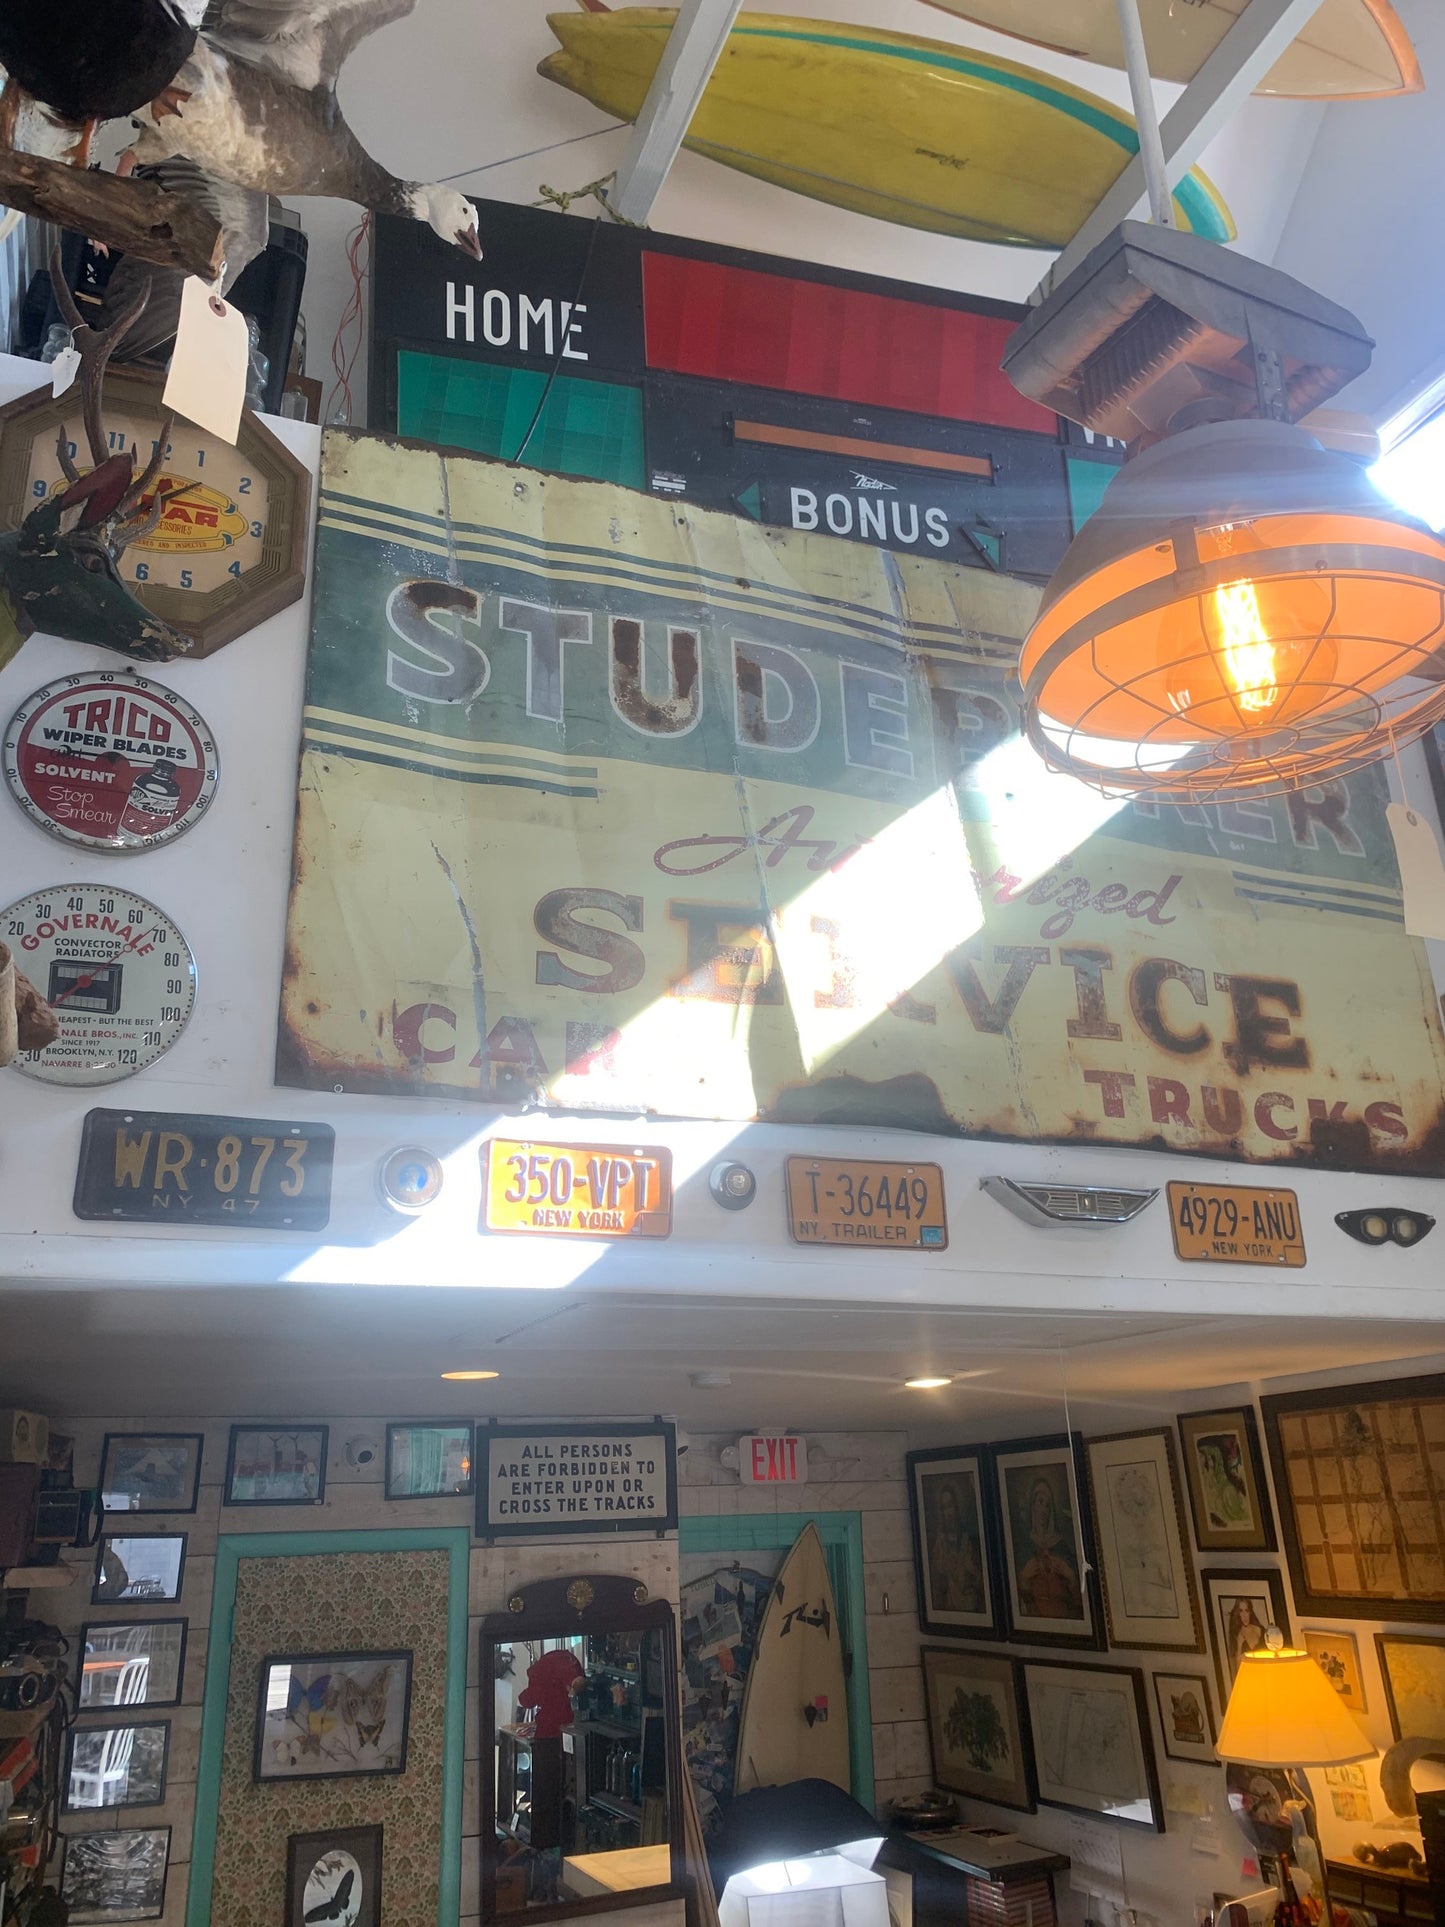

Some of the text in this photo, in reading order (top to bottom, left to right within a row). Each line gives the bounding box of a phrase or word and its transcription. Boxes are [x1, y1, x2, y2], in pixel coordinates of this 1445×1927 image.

[446, 281, 589, 361] HOME
[109, 431, 126, 450] 11
[197, 450, 206, 467] 1
[33, 480, 47, 497] 9
[239, 477, 252, 494] 2
[790, 487, 950, 547] BONUS
[250, 521, 263, 538] 3
[135, 563, 149, 580] 6
[228, 561, 241, 578] 4
[180, 570, 193, 589] 5
[66, 677, 80, 687] 30
[100, 674, 114, 682] 40
[134, 679, 148, 689] 50
[36, 690, 50, 702] 20
[164, 693, 177, 705] 60
[16, 712, 27, 723] 10
[63, 696, 172, 743] TRICO
[188, 714, 200, 727] 70
[43, 728, 187, 761] WIPER BLADES
[202, 741, 213, 753] 80
[34, 762, 116, 784] SOLVENT
[206, 769, 216, 781] 90
[47, 786, 94, 805] Stop
[55, 803, 117, 825] Smear
[35, 904, 51, 919] 30
[67, 897, 83, 912] 40
[99, 899, 114, 914] 50
[128, 909, 143, 924] 60
[8, 921, 24, 936] 20
[20, 913, 156, 957] GOVERNALE
[152, 929, 166, 943] 70
[54, 938, 121, 949] CONVECTOR
[55, 948, 120, 959] RADIATORS
[164, 952, 179, 967] 80
[166, 979, 182, 994] 90
[99, 1017, 114, 1025] BUT
[160, 1007, 180, 1022] 100
[143, 1031, 161, 1046] 110
[41, 1060, 82, 1068] NAVARRE
[46, 1047, 97, 1057] BROOKLYN,
[117, 1049, 137, 1064] 120
[1083, 1069, 1411, 1146] TRUCKS
[505, 1155, 656, 1212] 350-VPT
[805, 1171, 928, 1220] T-36449
[221, 1198, 260, 1214] 47
[532, 1209, 625, 1229] NEW YORK
[1179, 1195, 1297, 1241] 4929-ANU
[832, 1223, 907, 1240] TRAILER
[1212, 1241, 1274, 1257] NEW YORK
[521, 1443, 633, 1460] ALL PERSONS
[751, 1438, 798, 1481] EXIT
[498, 1460, 655, 1478] ARE FORBIDDEN TO
[511, 1478, 644, 1496] ENTER UPON OR
[499, 1496, 655, 1514] CROSS THE TRACKS
